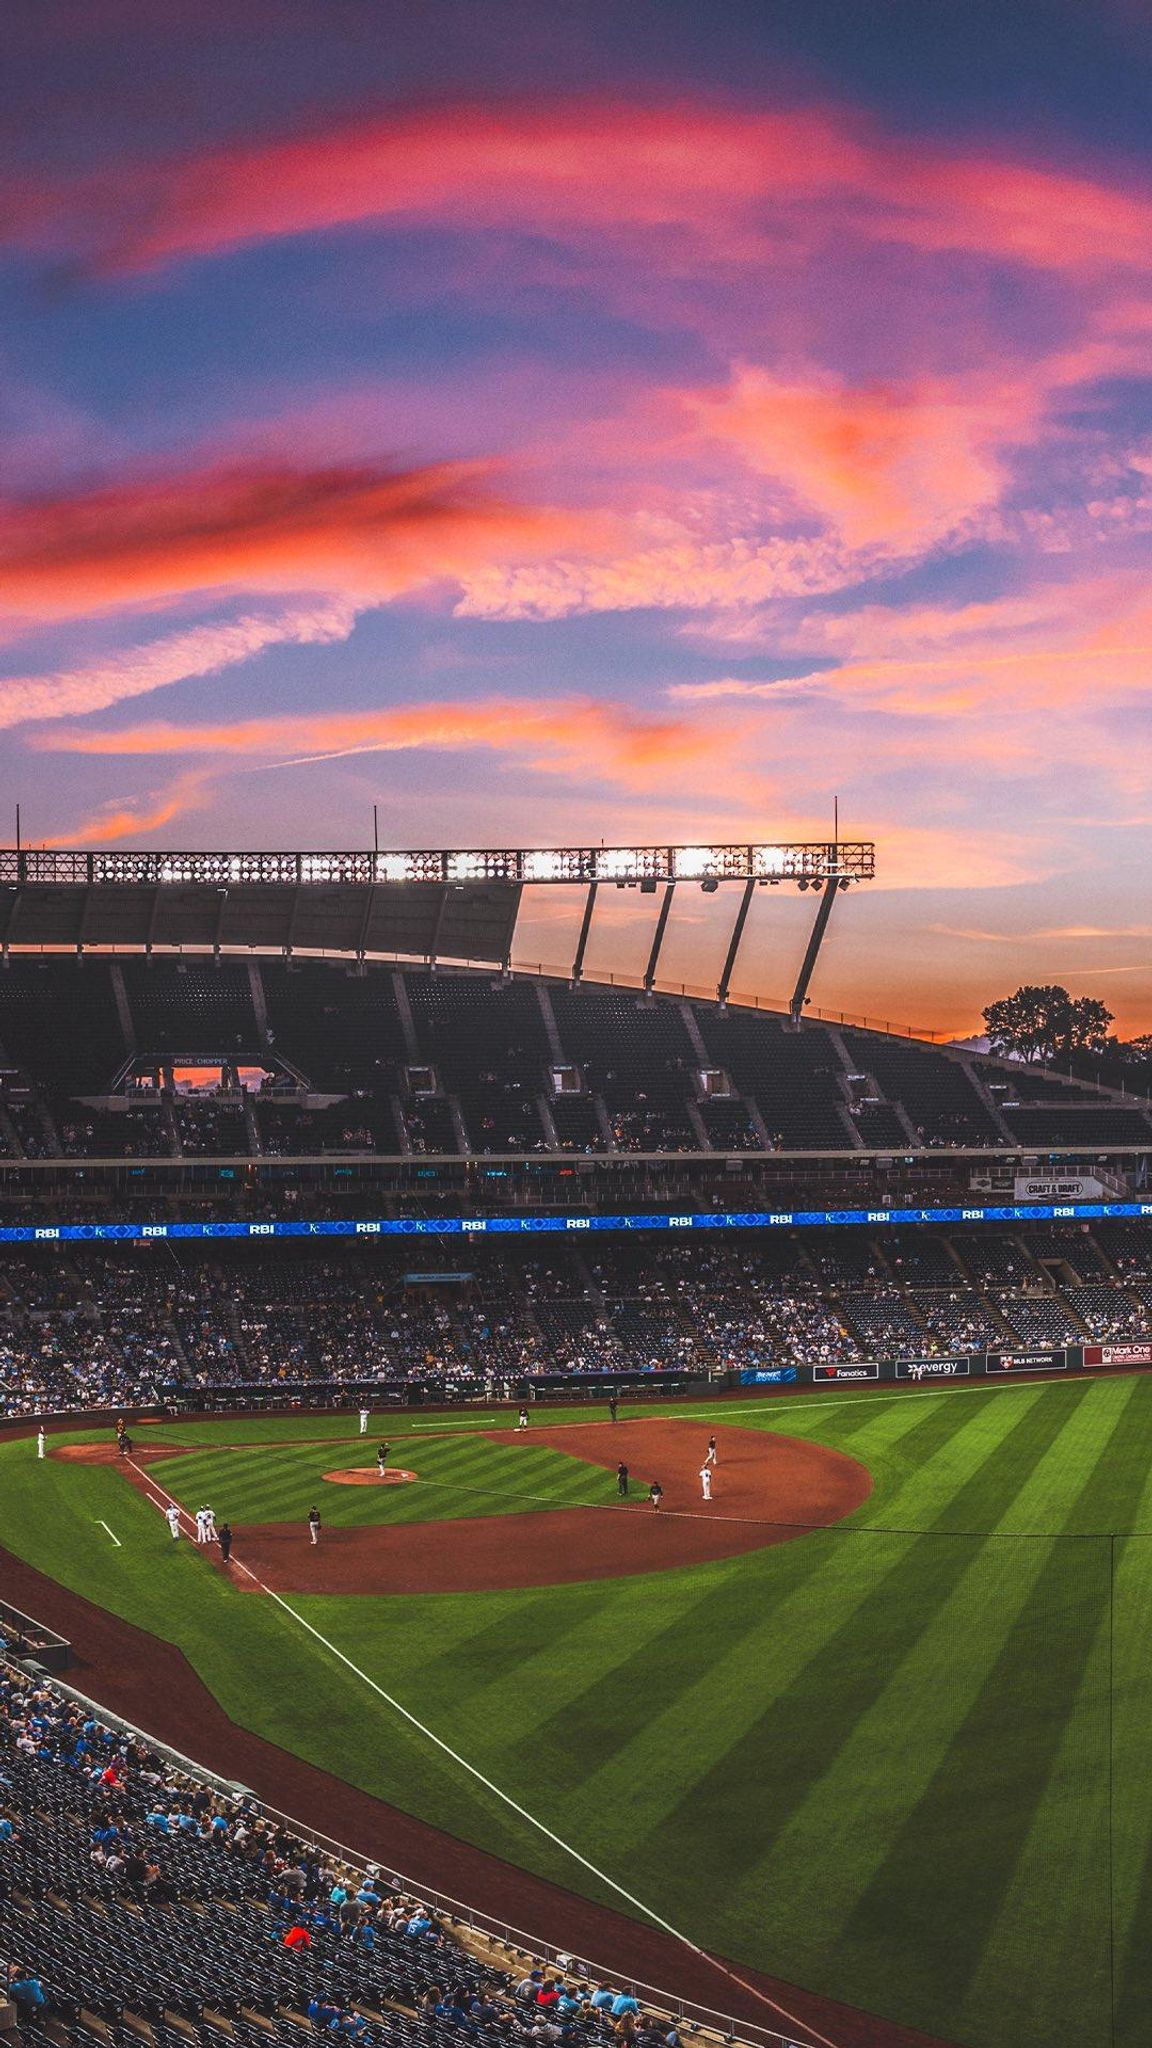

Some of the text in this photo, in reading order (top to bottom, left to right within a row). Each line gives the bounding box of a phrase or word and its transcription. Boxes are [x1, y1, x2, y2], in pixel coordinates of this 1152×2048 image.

[1028, 1184, 1050, 1193] CRAFT
[1058, 1184, 1080, 1193] DRAFT
[35, 1228, 60, 1239] RBI
[142, 1226, 167, 1236] RBI
[249, 1224, 275, 1234] RBI
[356, 1223, 381, 1233] RBI
[462, 1221, 486, 1231] RBI
[566, 1219, 590, 1229] RBI
[669, 1217, 693, 1226] RBI
[770, 1215, 793, 1224] RBI
[868, 1212, 890, 1221] RBI
[962, 1210, 984, 1219] RBI
[1053, 1207, 1074, 1217] RBI
[1112, 1345, 1150, 1355] Mark One
[1026, 1356, 1053, 1364] NETWORK
[919, 1362, 958, 1374] evergy
[836, 1369, 868, 1378] Fanatics
